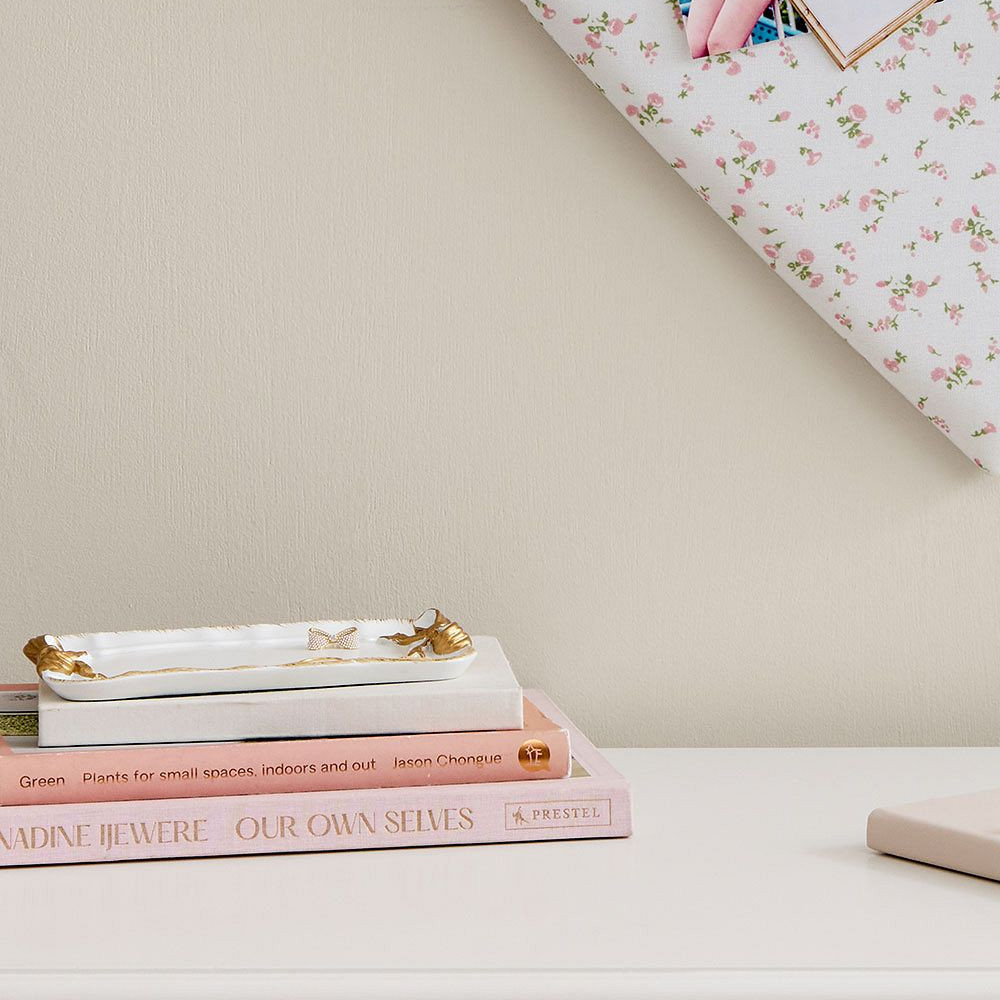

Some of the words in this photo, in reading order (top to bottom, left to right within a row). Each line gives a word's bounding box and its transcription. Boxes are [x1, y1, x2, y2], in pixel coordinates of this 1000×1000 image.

[19, 774, 65, 789] Green
[82, 771, 129, 786] Plants
[133, 769, 155, 783] for
[159, 767, 198, 781] small
[261, 762, 317, 777] indoors
[320, 759, 348, 773] and
[352, 757, 377, 771] out
[392, 756, 432, 770] Jason
[436, 753, 503, 770] Chongue
[0, 823, 92, 850] NADINE
[99, 818, 209, 851] IJEWERE
[235, 815, 300, 840] OUR
[306, 810, 376, 838] OWN
[383, 806, 475, 835] SELVES
[531, 806, 602, 821] PRESTEL
